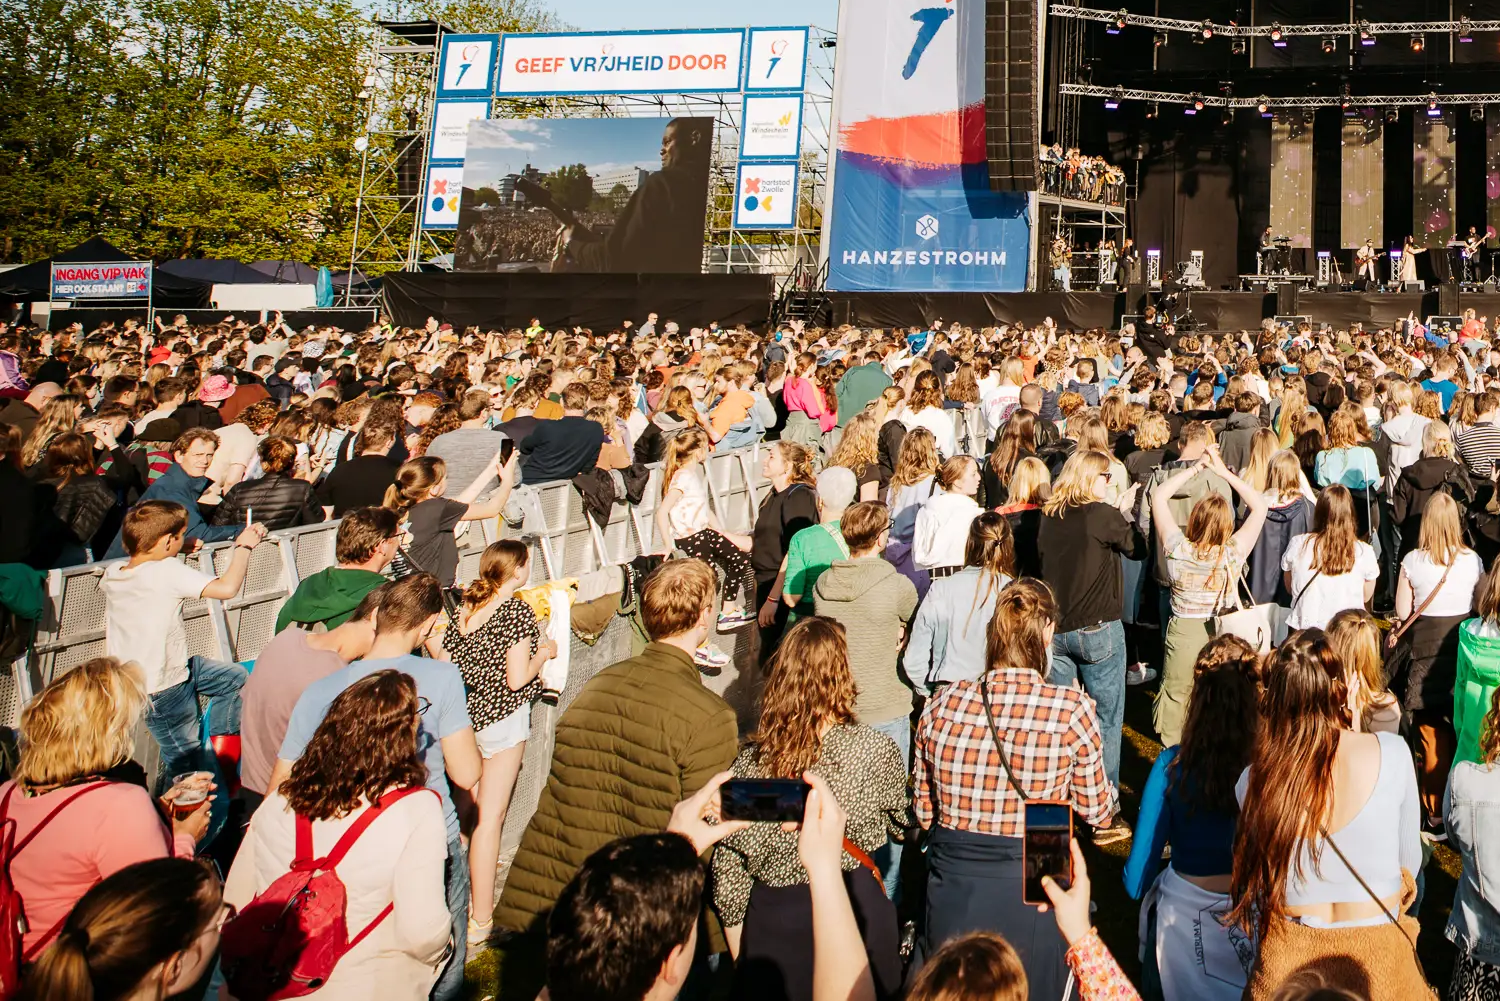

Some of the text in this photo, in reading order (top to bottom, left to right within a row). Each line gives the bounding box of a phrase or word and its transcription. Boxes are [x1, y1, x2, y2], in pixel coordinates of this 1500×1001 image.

[515, 54, 727, 74] GEEF VRIJHEID DOOR
[842, 249, 1007, 266] HANZESTROHM
[55, 267, 147, 281] INGANG VIP VAK
[55, 284, 74, 294] HIER
[74, 284, 92, 293] OOK
